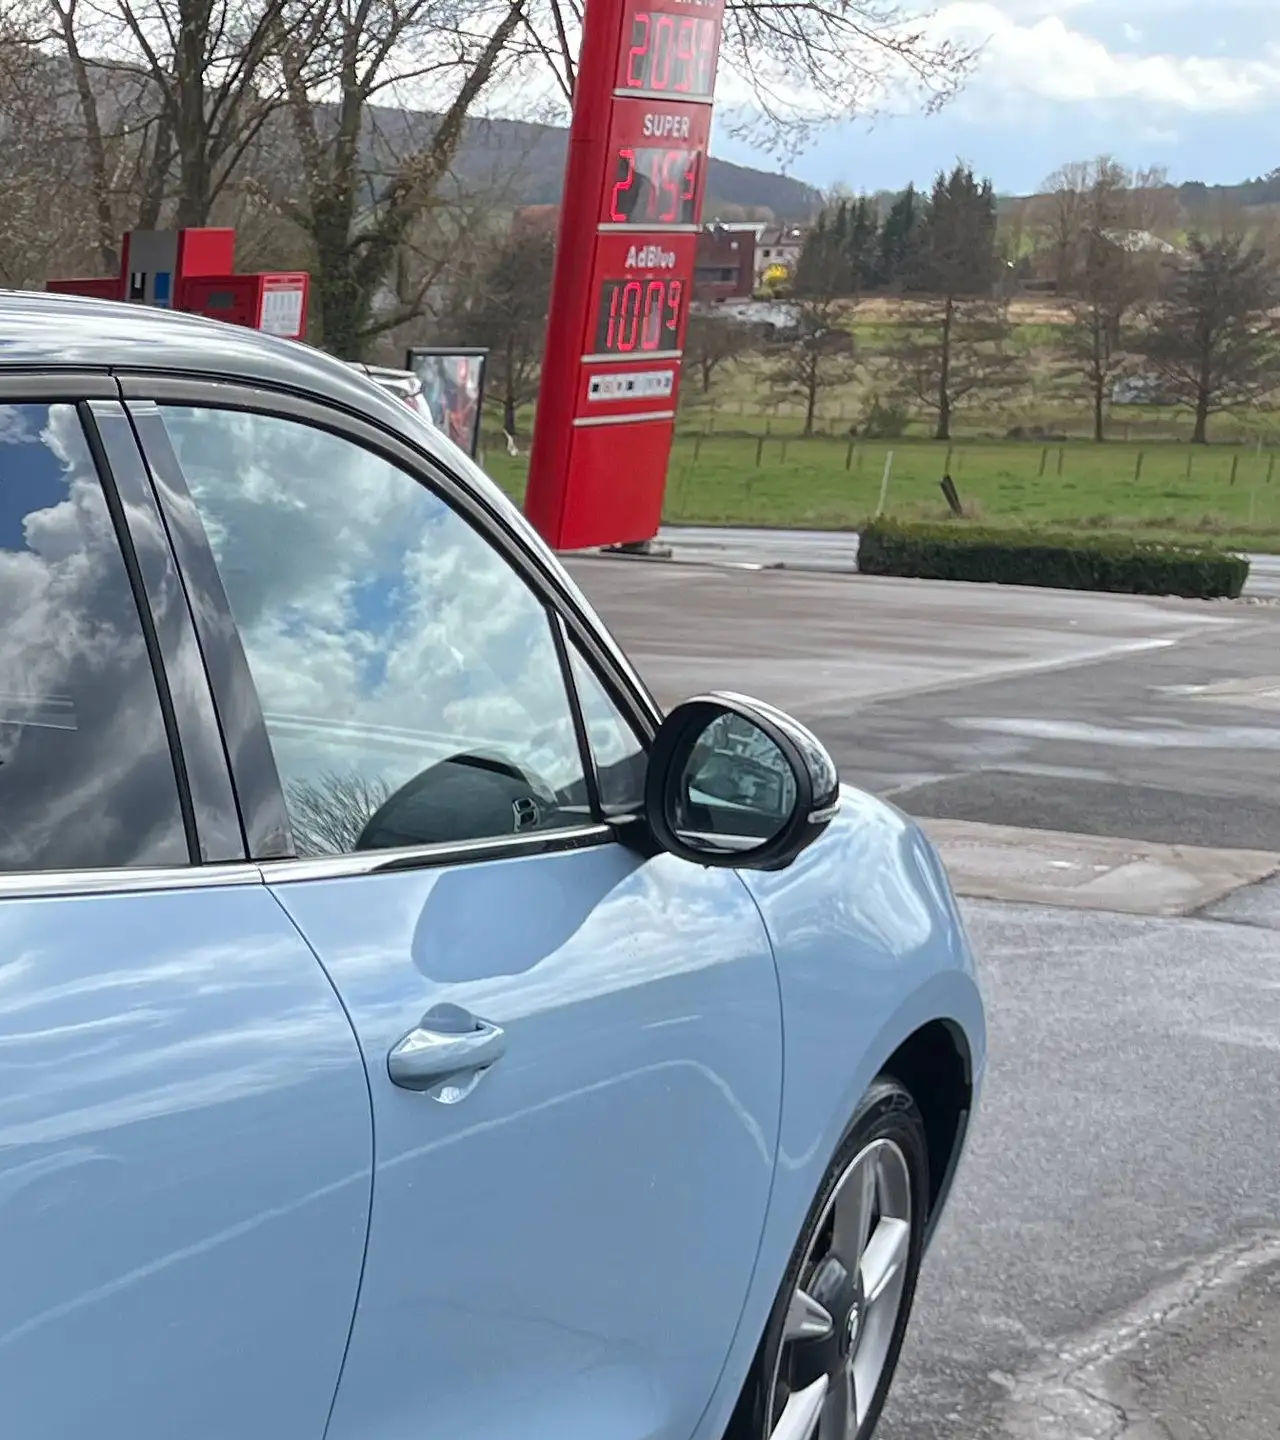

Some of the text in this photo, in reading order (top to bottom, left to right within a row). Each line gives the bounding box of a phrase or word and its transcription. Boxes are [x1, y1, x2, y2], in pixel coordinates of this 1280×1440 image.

[643, 113, 690, 137] SUPER
[624, 244, 676, 268] AdBlue
[606, 280, 682, 351] 1009
